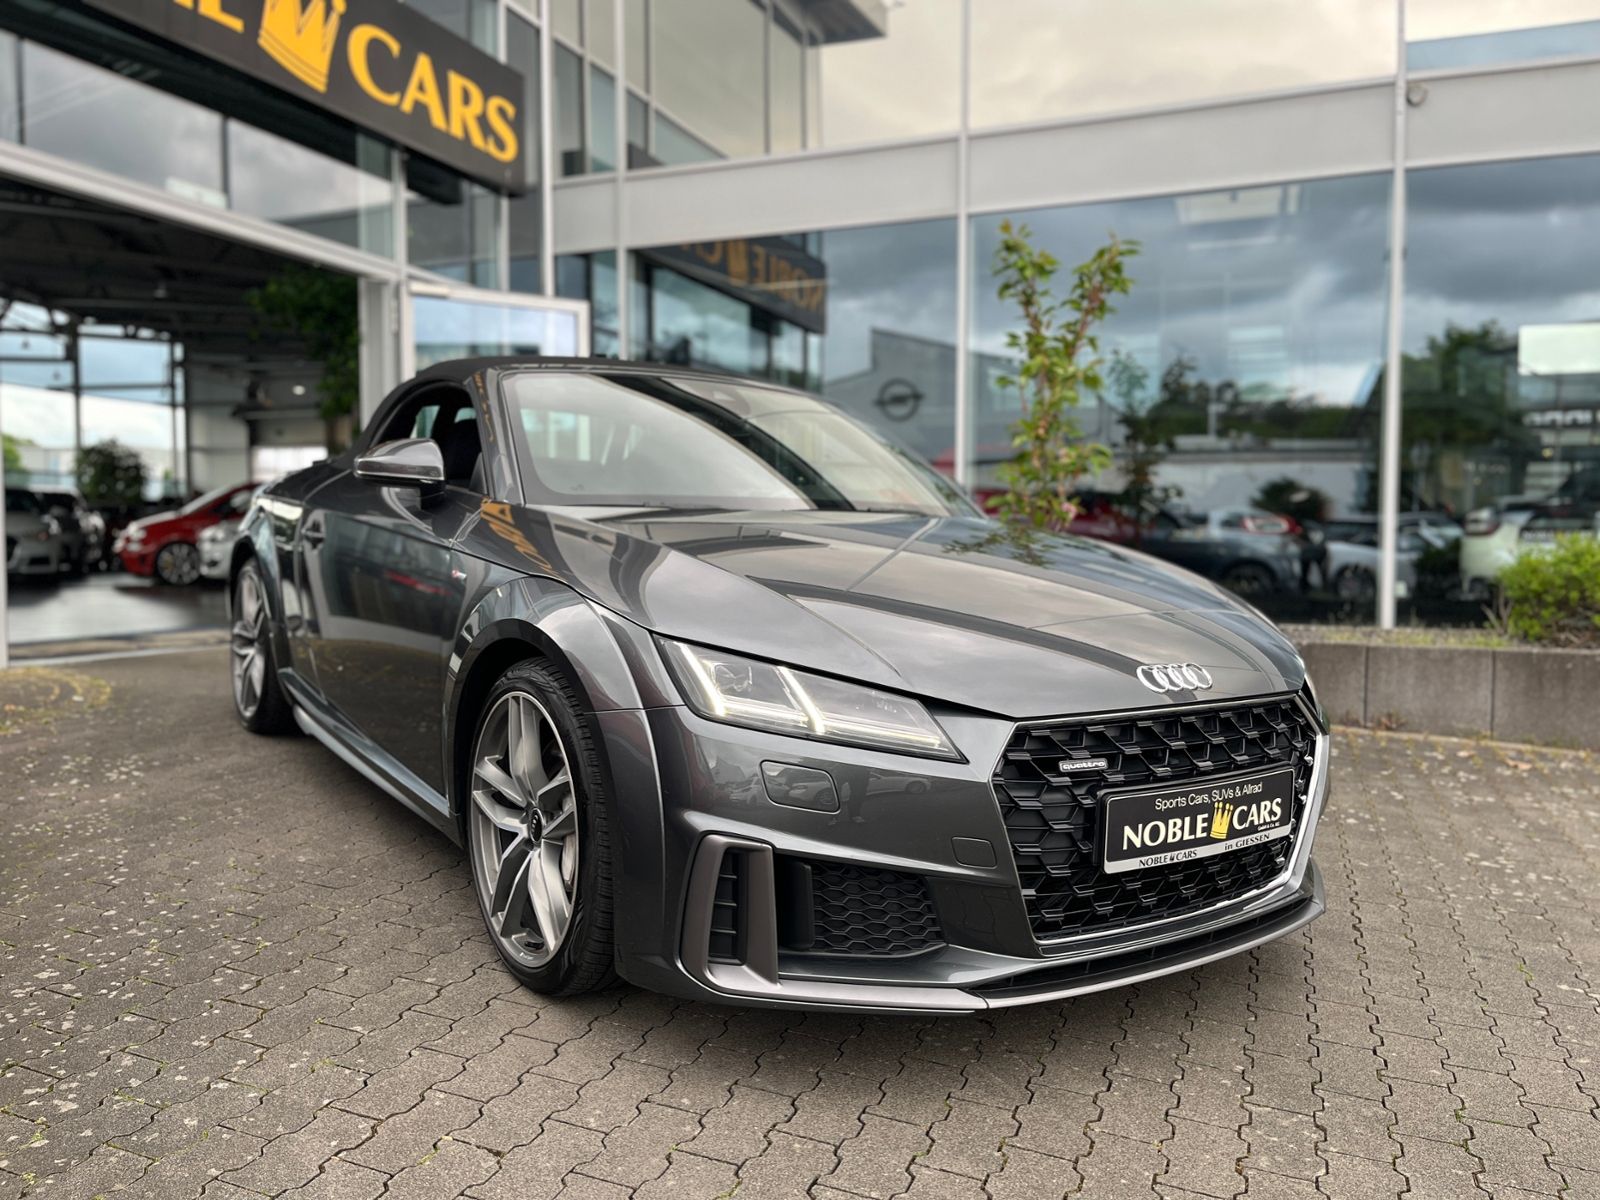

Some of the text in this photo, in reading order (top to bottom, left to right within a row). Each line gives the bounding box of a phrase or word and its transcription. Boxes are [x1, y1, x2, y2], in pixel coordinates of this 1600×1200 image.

[347, 23, 519, 163] CARS
[1062, 761, 1105, 770] quattro
[1154, 781, 1263, 811] Sports Cars, SUVs & Allrad
[1122, 797, 1282, 850] NOBLE CARS
[1224, 833, 1270, 850] in GIESSEN
[1138, 849, 1198, 867] NOBLE CARS
